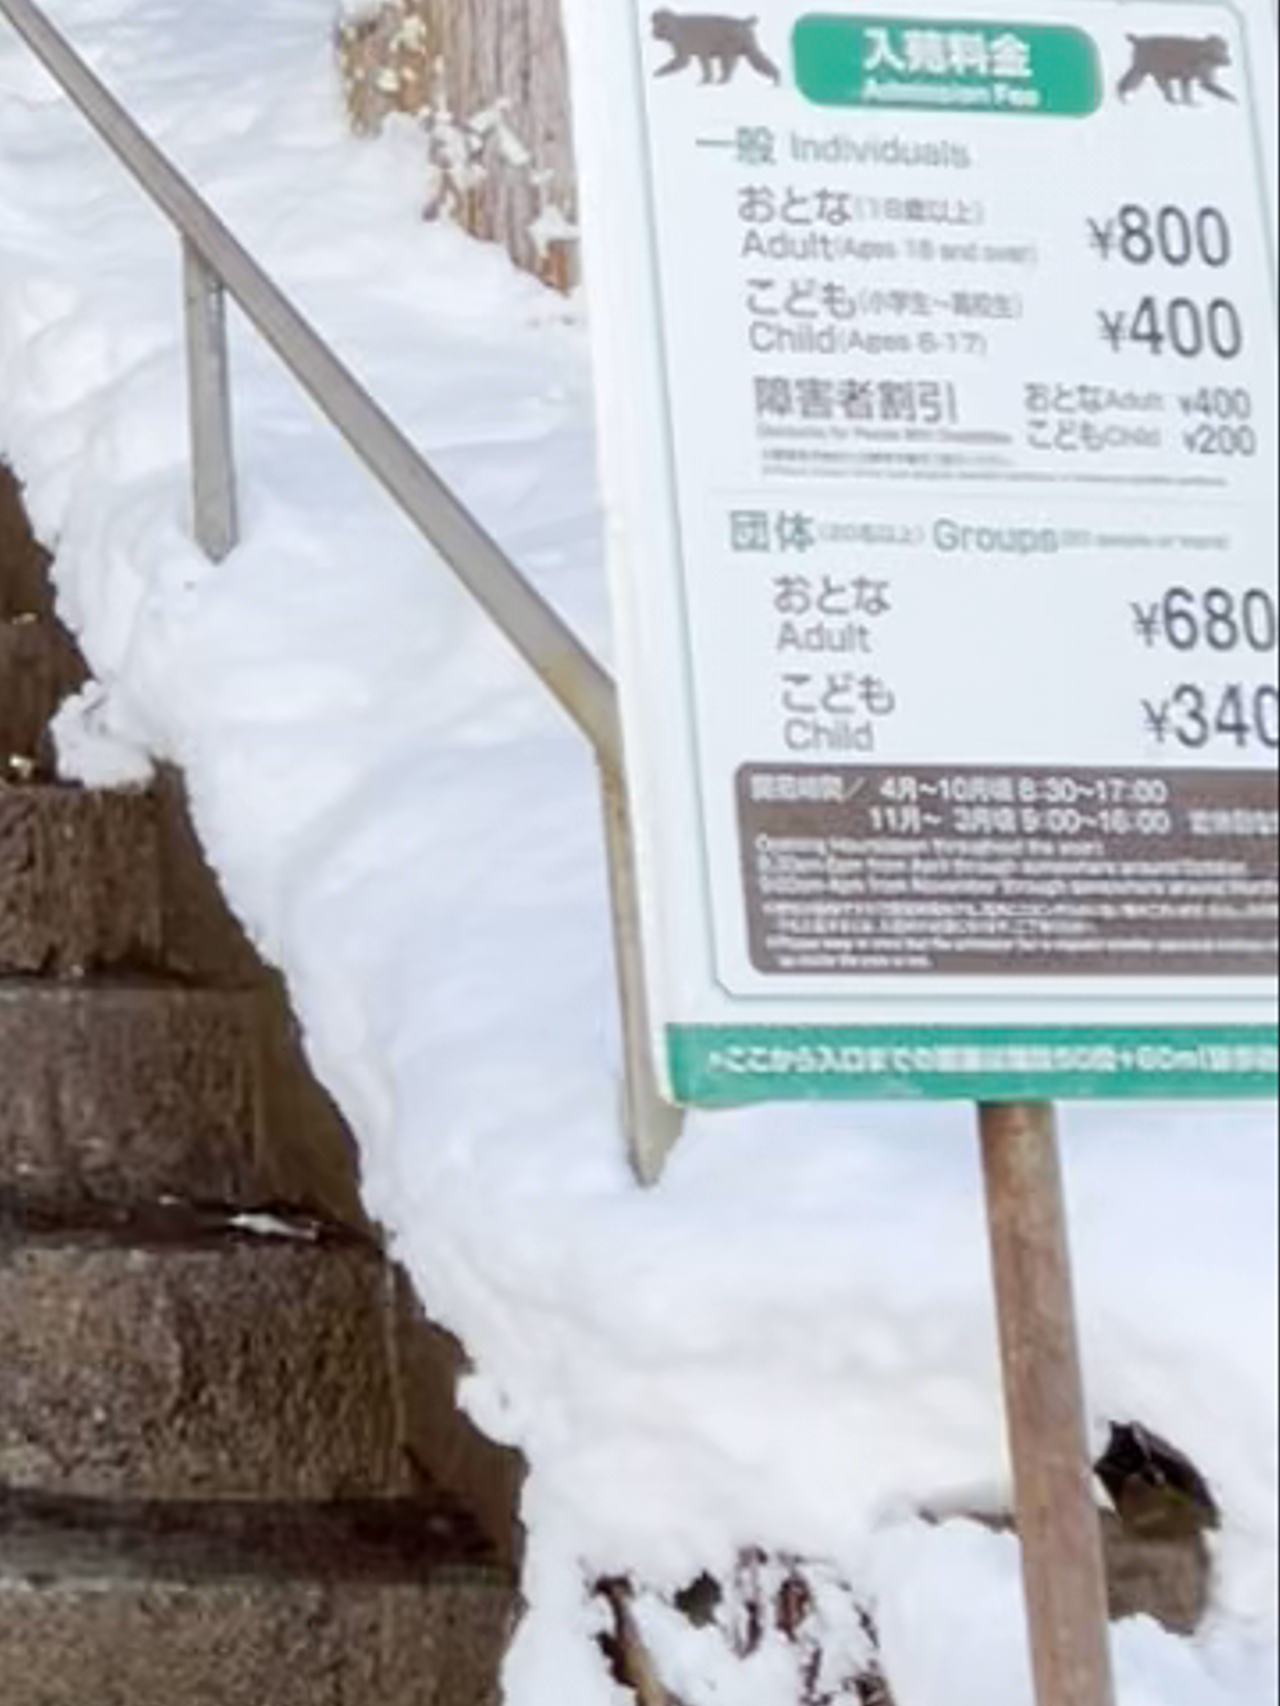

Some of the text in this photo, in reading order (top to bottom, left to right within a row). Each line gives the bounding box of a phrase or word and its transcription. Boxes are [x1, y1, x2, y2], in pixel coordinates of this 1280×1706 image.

[695, 126, 972, 168] 一般 Individuals
[737, 186, 852, 226] おとな
[741, 229, 835, 261] Adult
[1086, 203, 1231, 268] ¥800
[746, 279, 856, 320] こども
[748, 320, 837, 354] Child
[1096, 296, 1243, 360] ¥400
[1179, 387, 1252, 420] ¥400
[1183, 424, 1257, 457] ¥200
[729, 510, 815, 553] 団体
[772, 575, 892, 616] おとな
[777, 621, 873, 654] Adult
[1128, 586, 1277, 653] ¥680
[781, 672, 896, 716] こども
[784, 717, 875, 752] Child
[1140, 683, 1279, 750] ¥340
